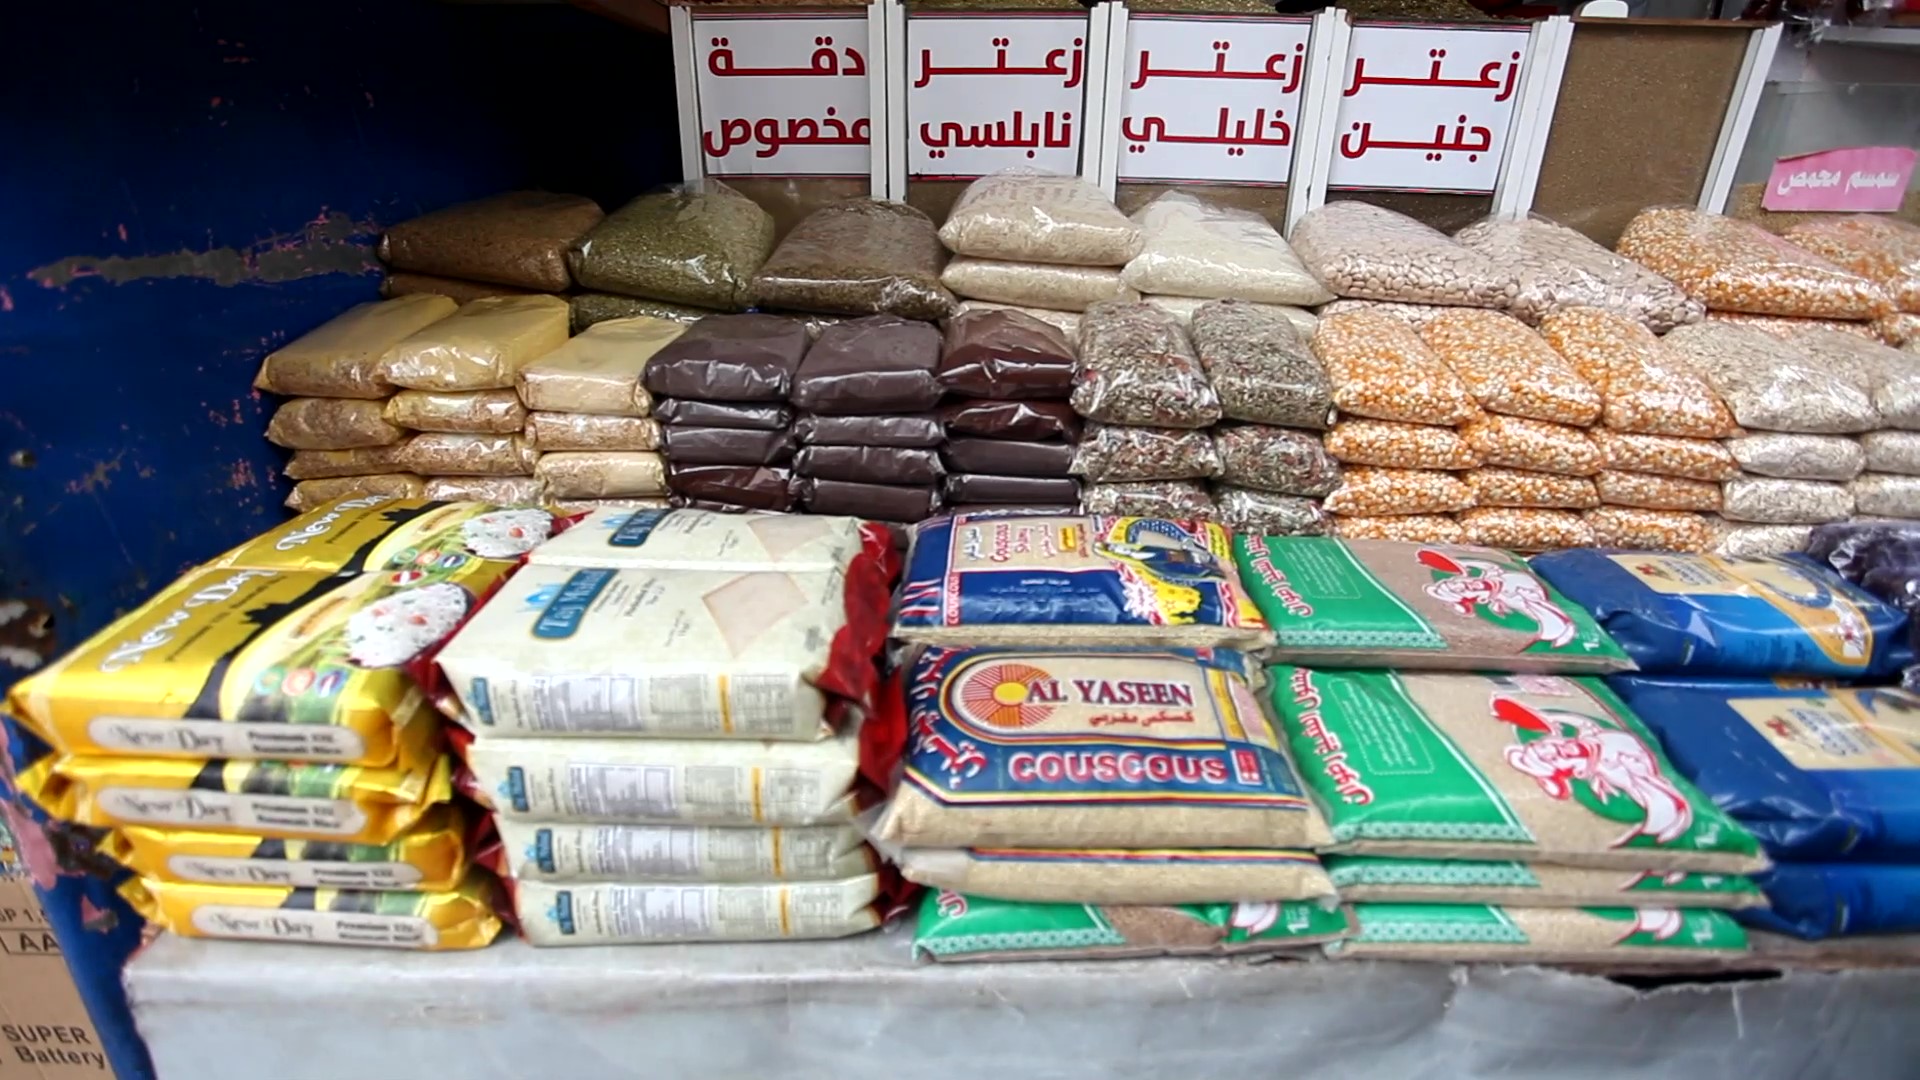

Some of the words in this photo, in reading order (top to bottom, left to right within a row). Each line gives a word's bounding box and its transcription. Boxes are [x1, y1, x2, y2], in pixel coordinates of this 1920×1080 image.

[914, 37, 1083, 88] زعتر
[1130, 41, 1305, 94] زعتر
[1343, 48, 1520, 102] زعتر
[704, 106, 871, 158] مخصوص
[920, 110, 1072, 159] نابلسي
[1122, 106, 1291, 156] خليلي
[1340, 114, 1492, 163] جنين
[1777, 170, 1841, 195] محمص
[1845, 171, 1899, 195] سمسم
[99, 609, 190, 673] New
[1027, 680, 1068, 703] AL
[1073, 679, 1195, 708] YASEEN
[1011, 751, 1229, 784] COUSCOUS
[1322, 750, 1374, 805] رضوان
[266, 917, 316, 937] Day
[2, 1024, 92, 1045] SUPER
[14, 1045, 105, 1070] Battery
